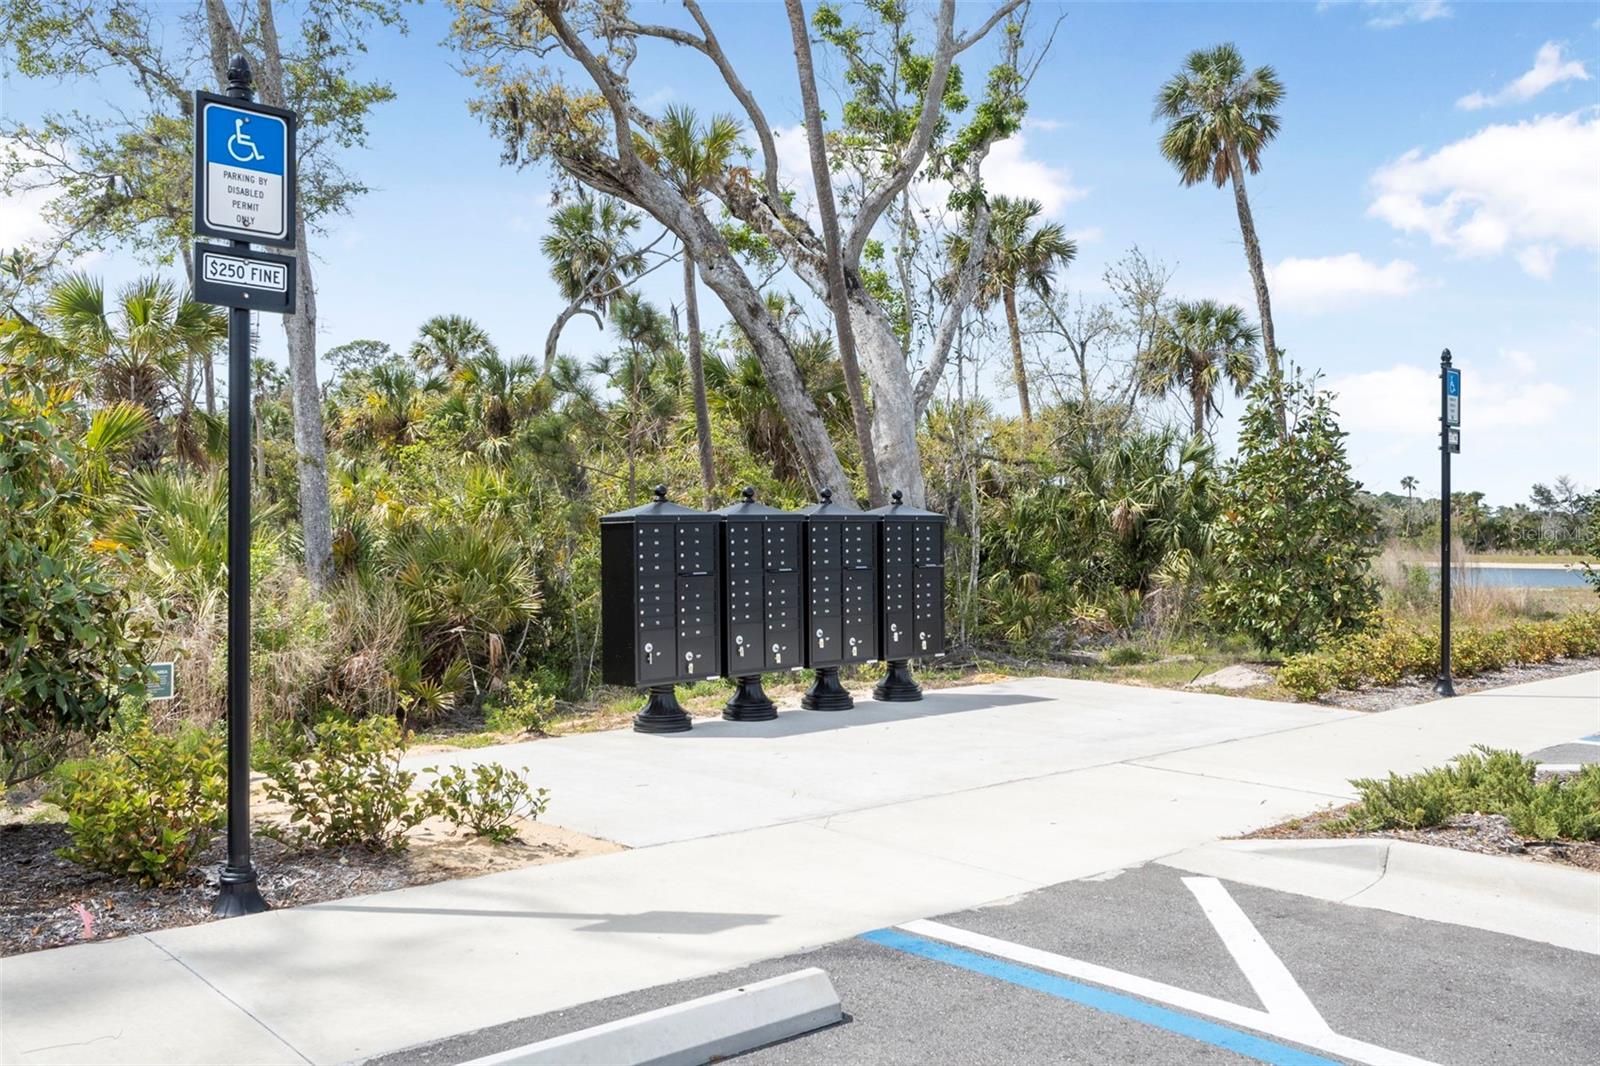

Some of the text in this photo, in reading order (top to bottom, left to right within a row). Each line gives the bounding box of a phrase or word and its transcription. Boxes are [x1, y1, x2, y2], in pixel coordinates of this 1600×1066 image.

[223, 170, 268, 186] PARKING BY
[227, 185, 264, 199] DISABLED
[232, 200, 259, 212] PERMIT
[236, 214, 255, 225] ONLY
[209, 259, 281, 284] $250 FINE
